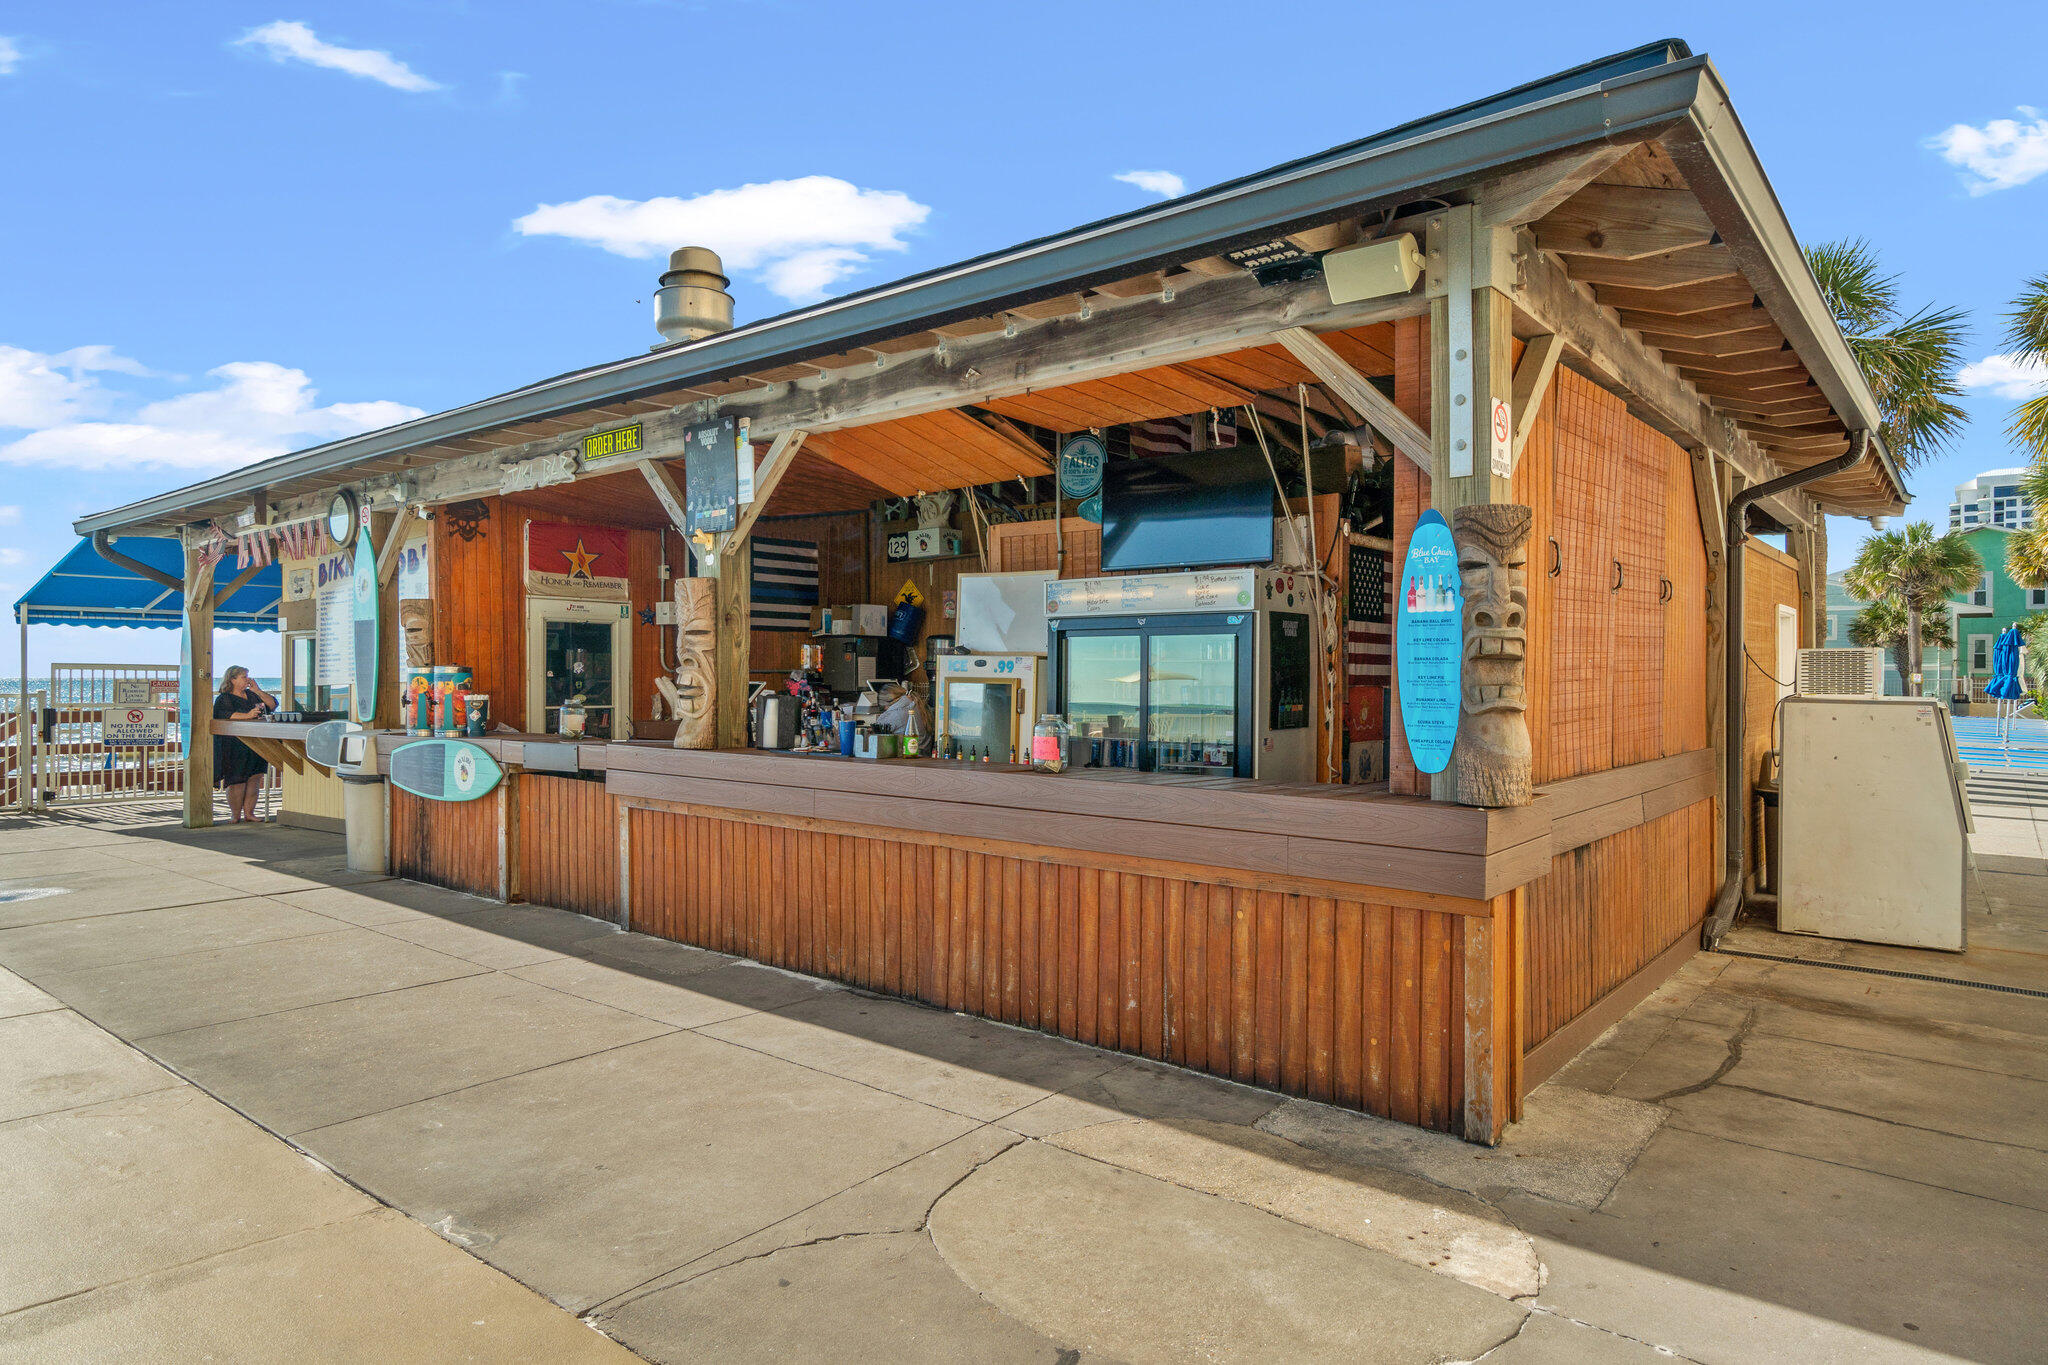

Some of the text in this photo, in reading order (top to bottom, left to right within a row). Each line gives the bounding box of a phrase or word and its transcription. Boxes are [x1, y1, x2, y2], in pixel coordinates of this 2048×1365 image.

[697, 427, 719, 440] ABSOLUT
[586, 428, 638, 458] ORDER HERE
[1497, 447, 1505, 460] NO
[1069, 455, 1099, 468] ALTOS
[1491, 457, 1510, 475] SMOKING
[890, 540, 907, 554] 129
[1411, 545, 1453, 560] Blue Chair
[1424, 556, 1440, 564] BAY
[541, 576, 572, 587] HONOR
[582, 580, 624, 591] REMEMBER
[948, 659, 1015, 673] ICE .99
